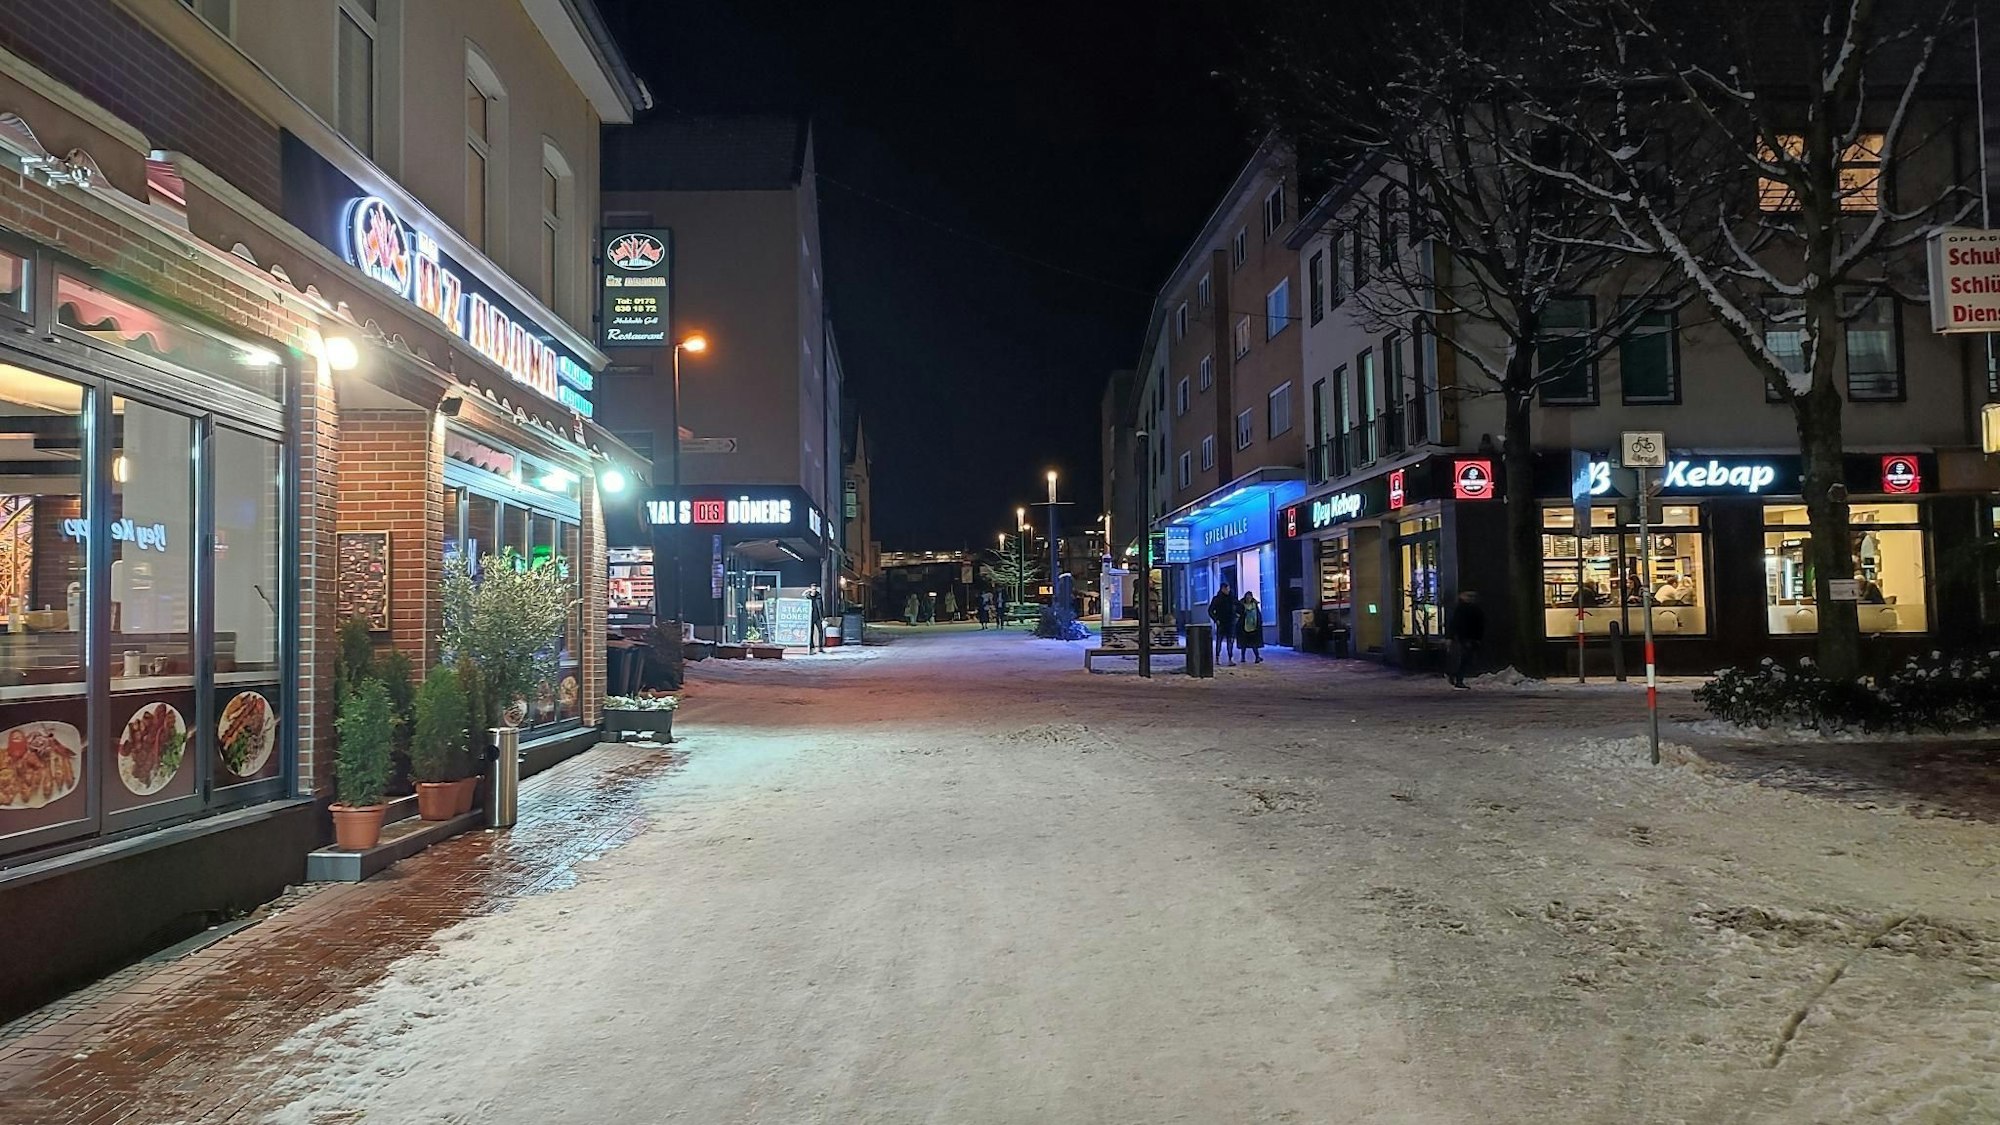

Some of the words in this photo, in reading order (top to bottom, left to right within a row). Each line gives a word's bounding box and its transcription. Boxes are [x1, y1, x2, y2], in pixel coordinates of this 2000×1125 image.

[1953, 304, 2000, 322] Dien
[607, 328, 664, 340] Restaurant
[1663, 460, 1775, 493] Kebap
[700, 504, 719, 521] DES
[727, 496, 792, 524] DÖNERS
[1312, 501, 1330, 528] Bey
[1331, 492, 1360, 518] Kebap
[1204, 517, 1248, 546] SPIELHALLE
